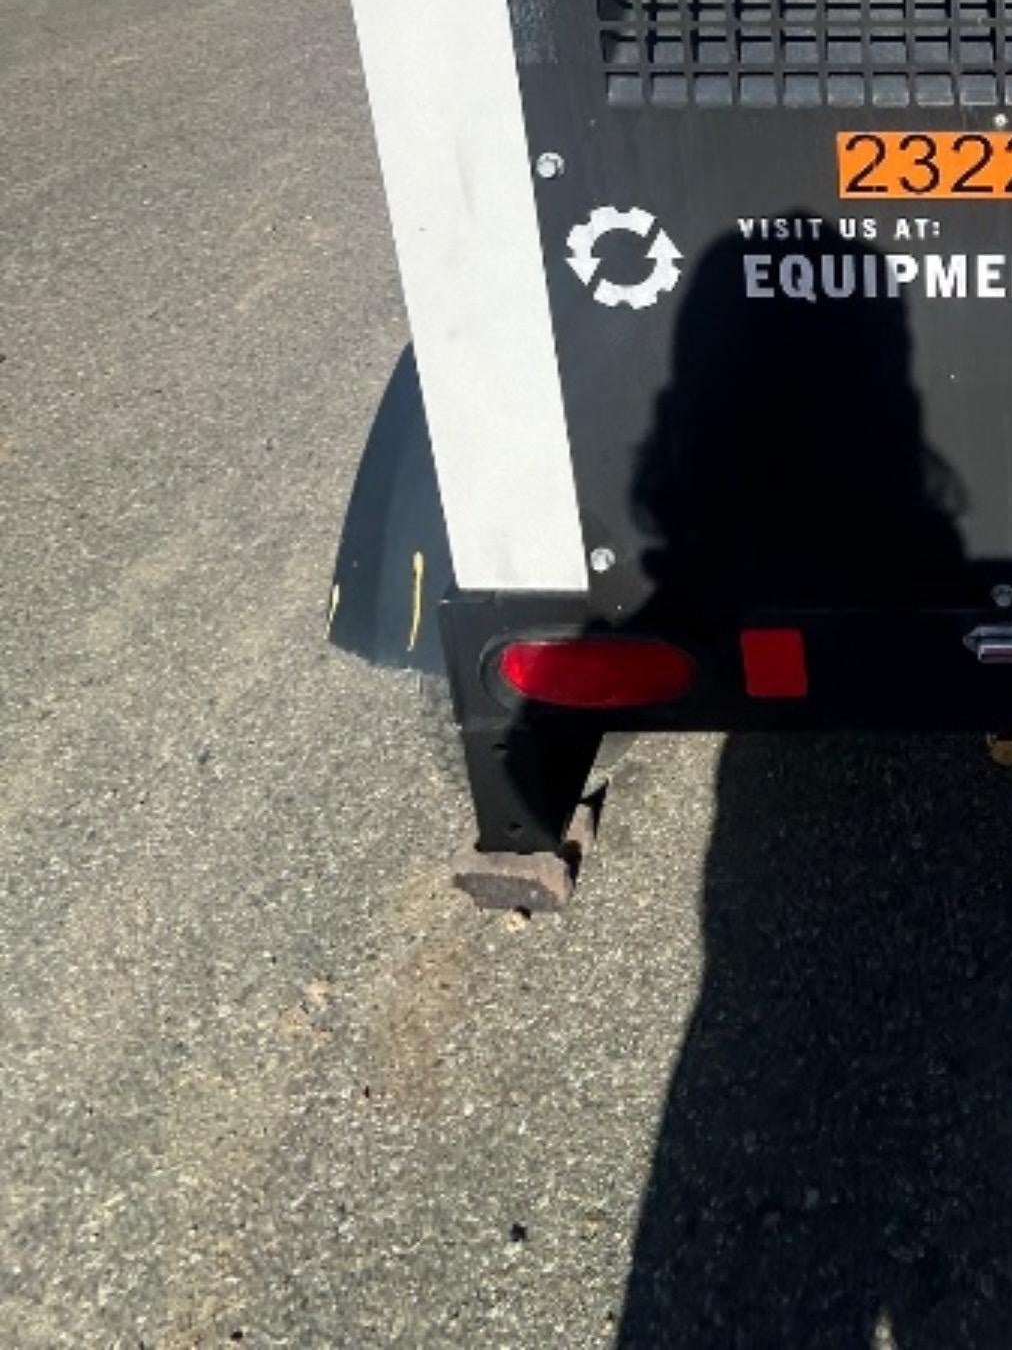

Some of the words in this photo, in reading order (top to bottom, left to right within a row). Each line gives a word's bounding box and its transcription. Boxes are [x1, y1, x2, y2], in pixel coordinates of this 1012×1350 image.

[737, 218, 824, 241] VISIT
[838, 218, 877, 240] US
[893, 218, 942, 240] AT:
